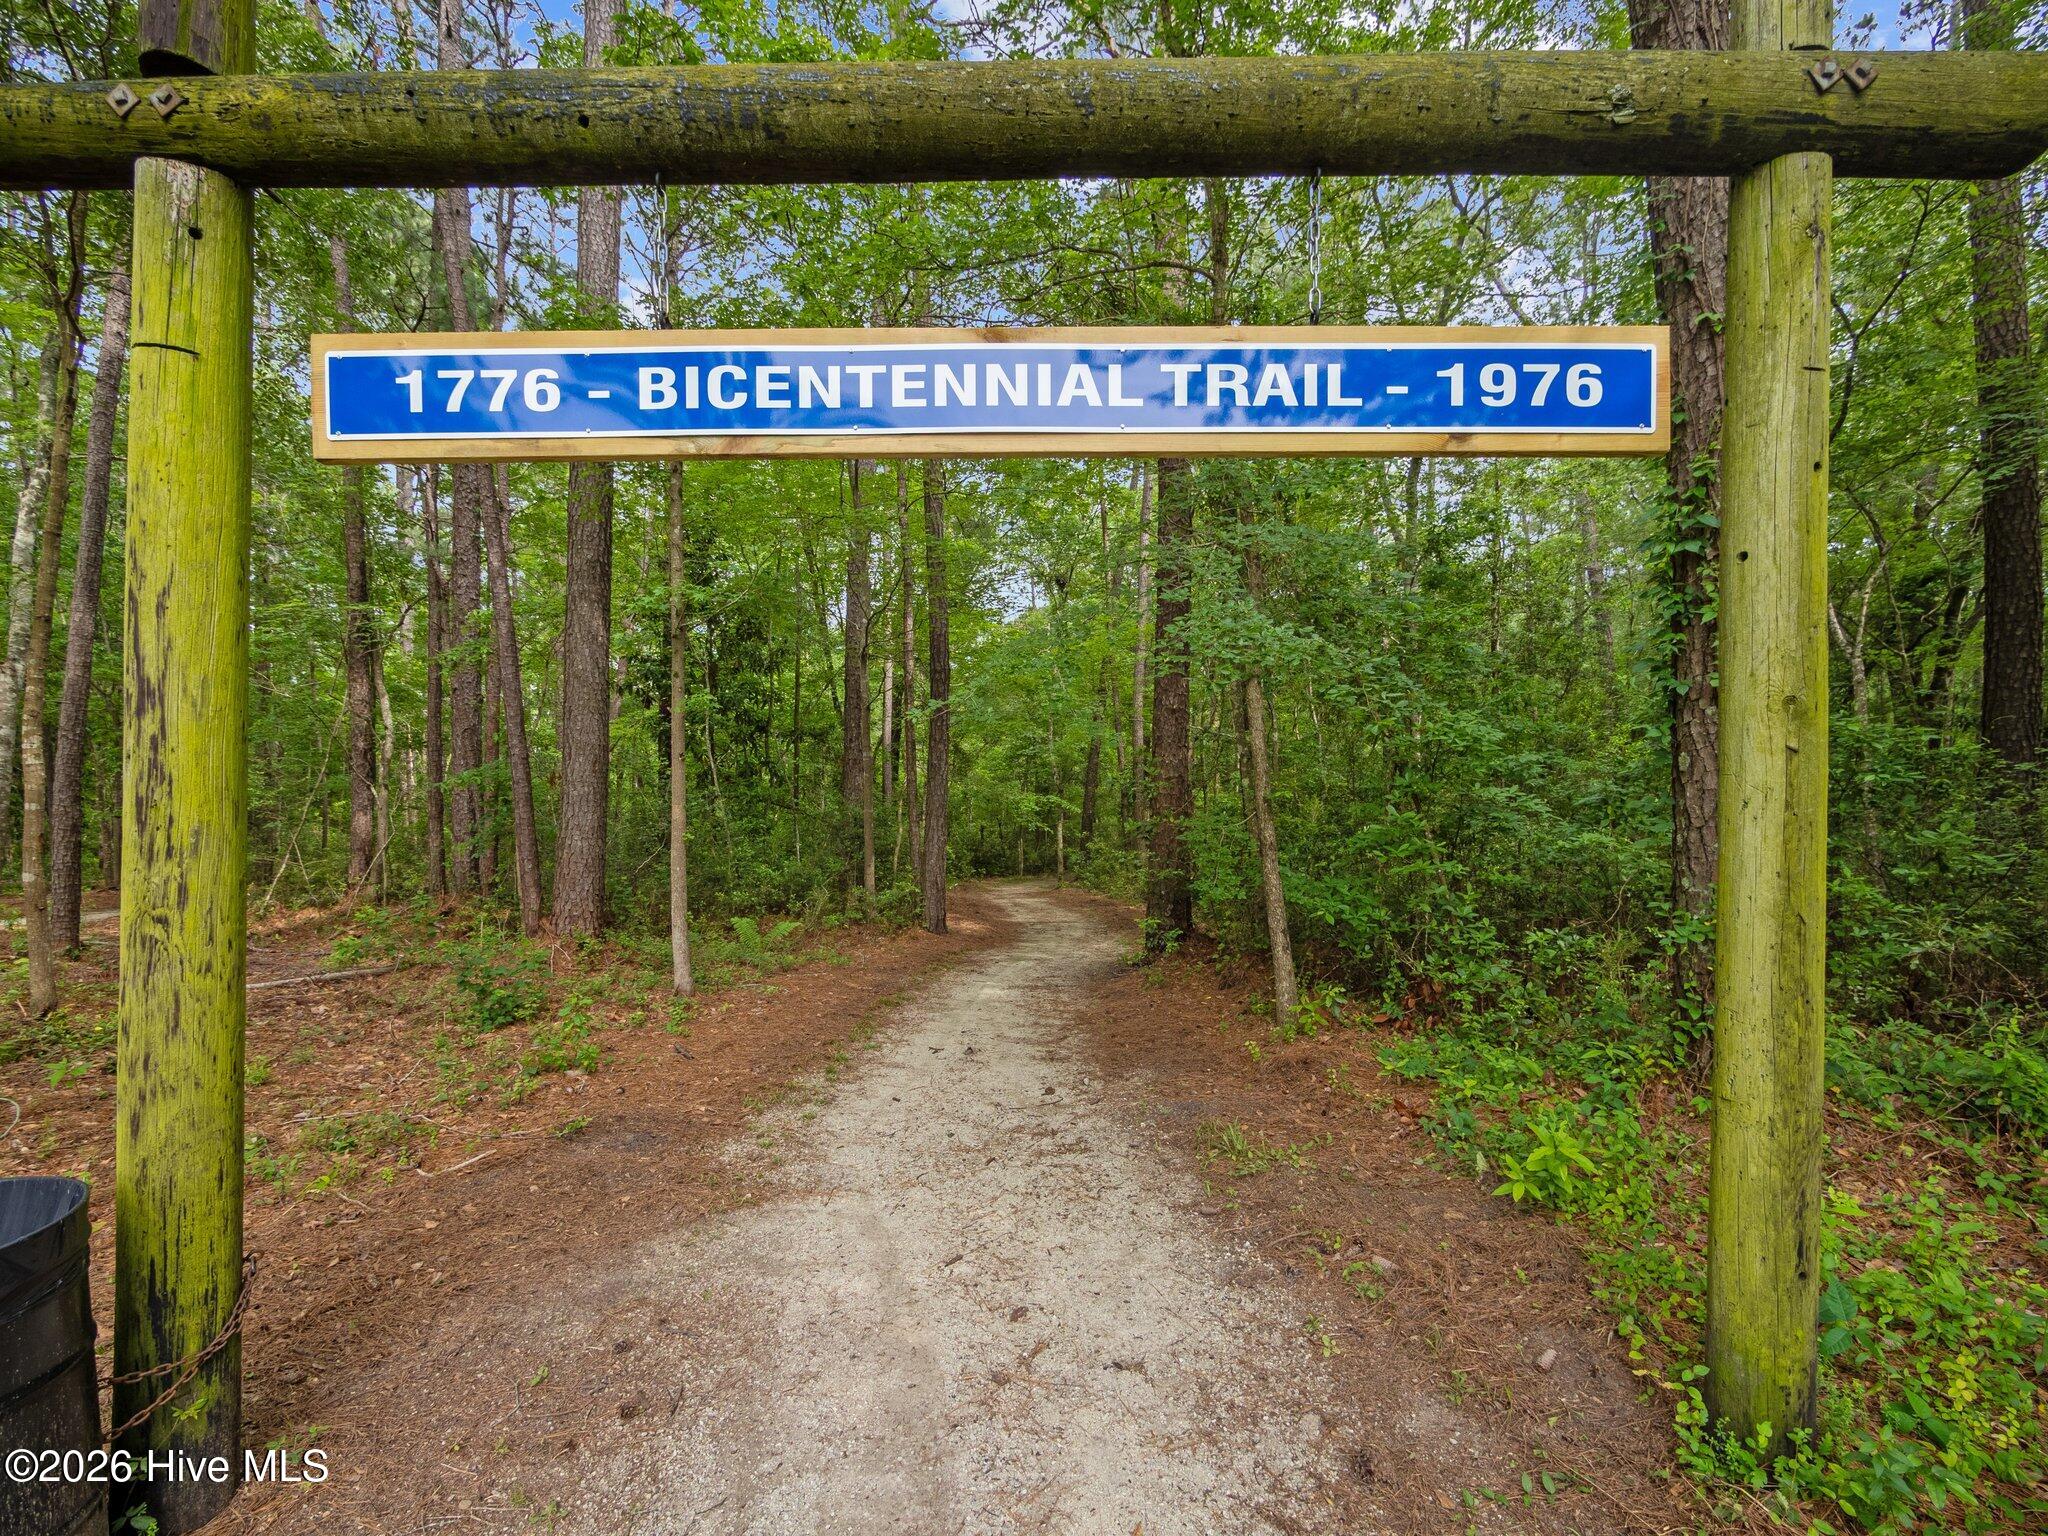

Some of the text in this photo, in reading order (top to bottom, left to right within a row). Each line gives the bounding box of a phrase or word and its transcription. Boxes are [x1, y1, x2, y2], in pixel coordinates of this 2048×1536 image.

[394, 362, 1604, 413] 1776 - BICENTENNIAL TRAIL - 1976
